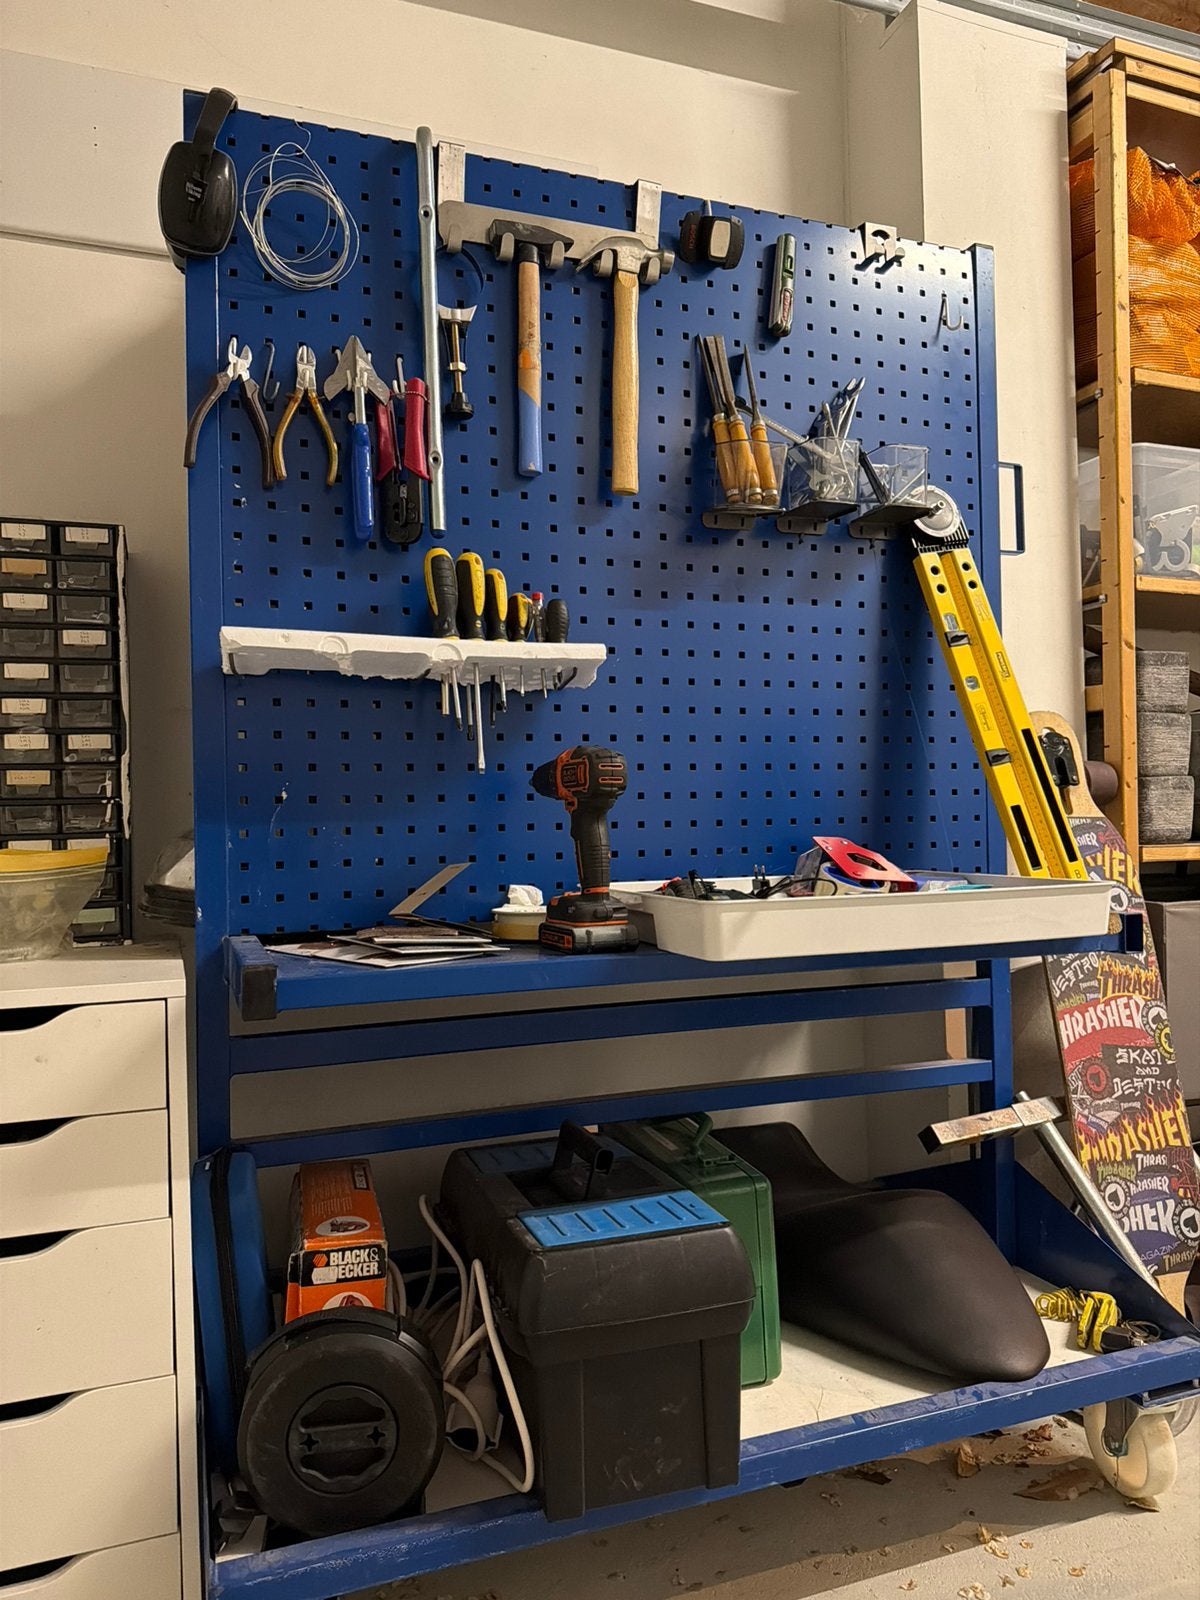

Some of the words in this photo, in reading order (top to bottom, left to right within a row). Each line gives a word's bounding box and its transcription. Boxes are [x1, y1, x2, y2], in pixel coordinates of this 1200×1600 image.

[1074, 869, 1082, 879] B
[1116, 1047, 1176, 1065] SKAT
[1135, 1066, 1160, 1076] AND
[1127, 1175, 1170, 1196] HRASHER
